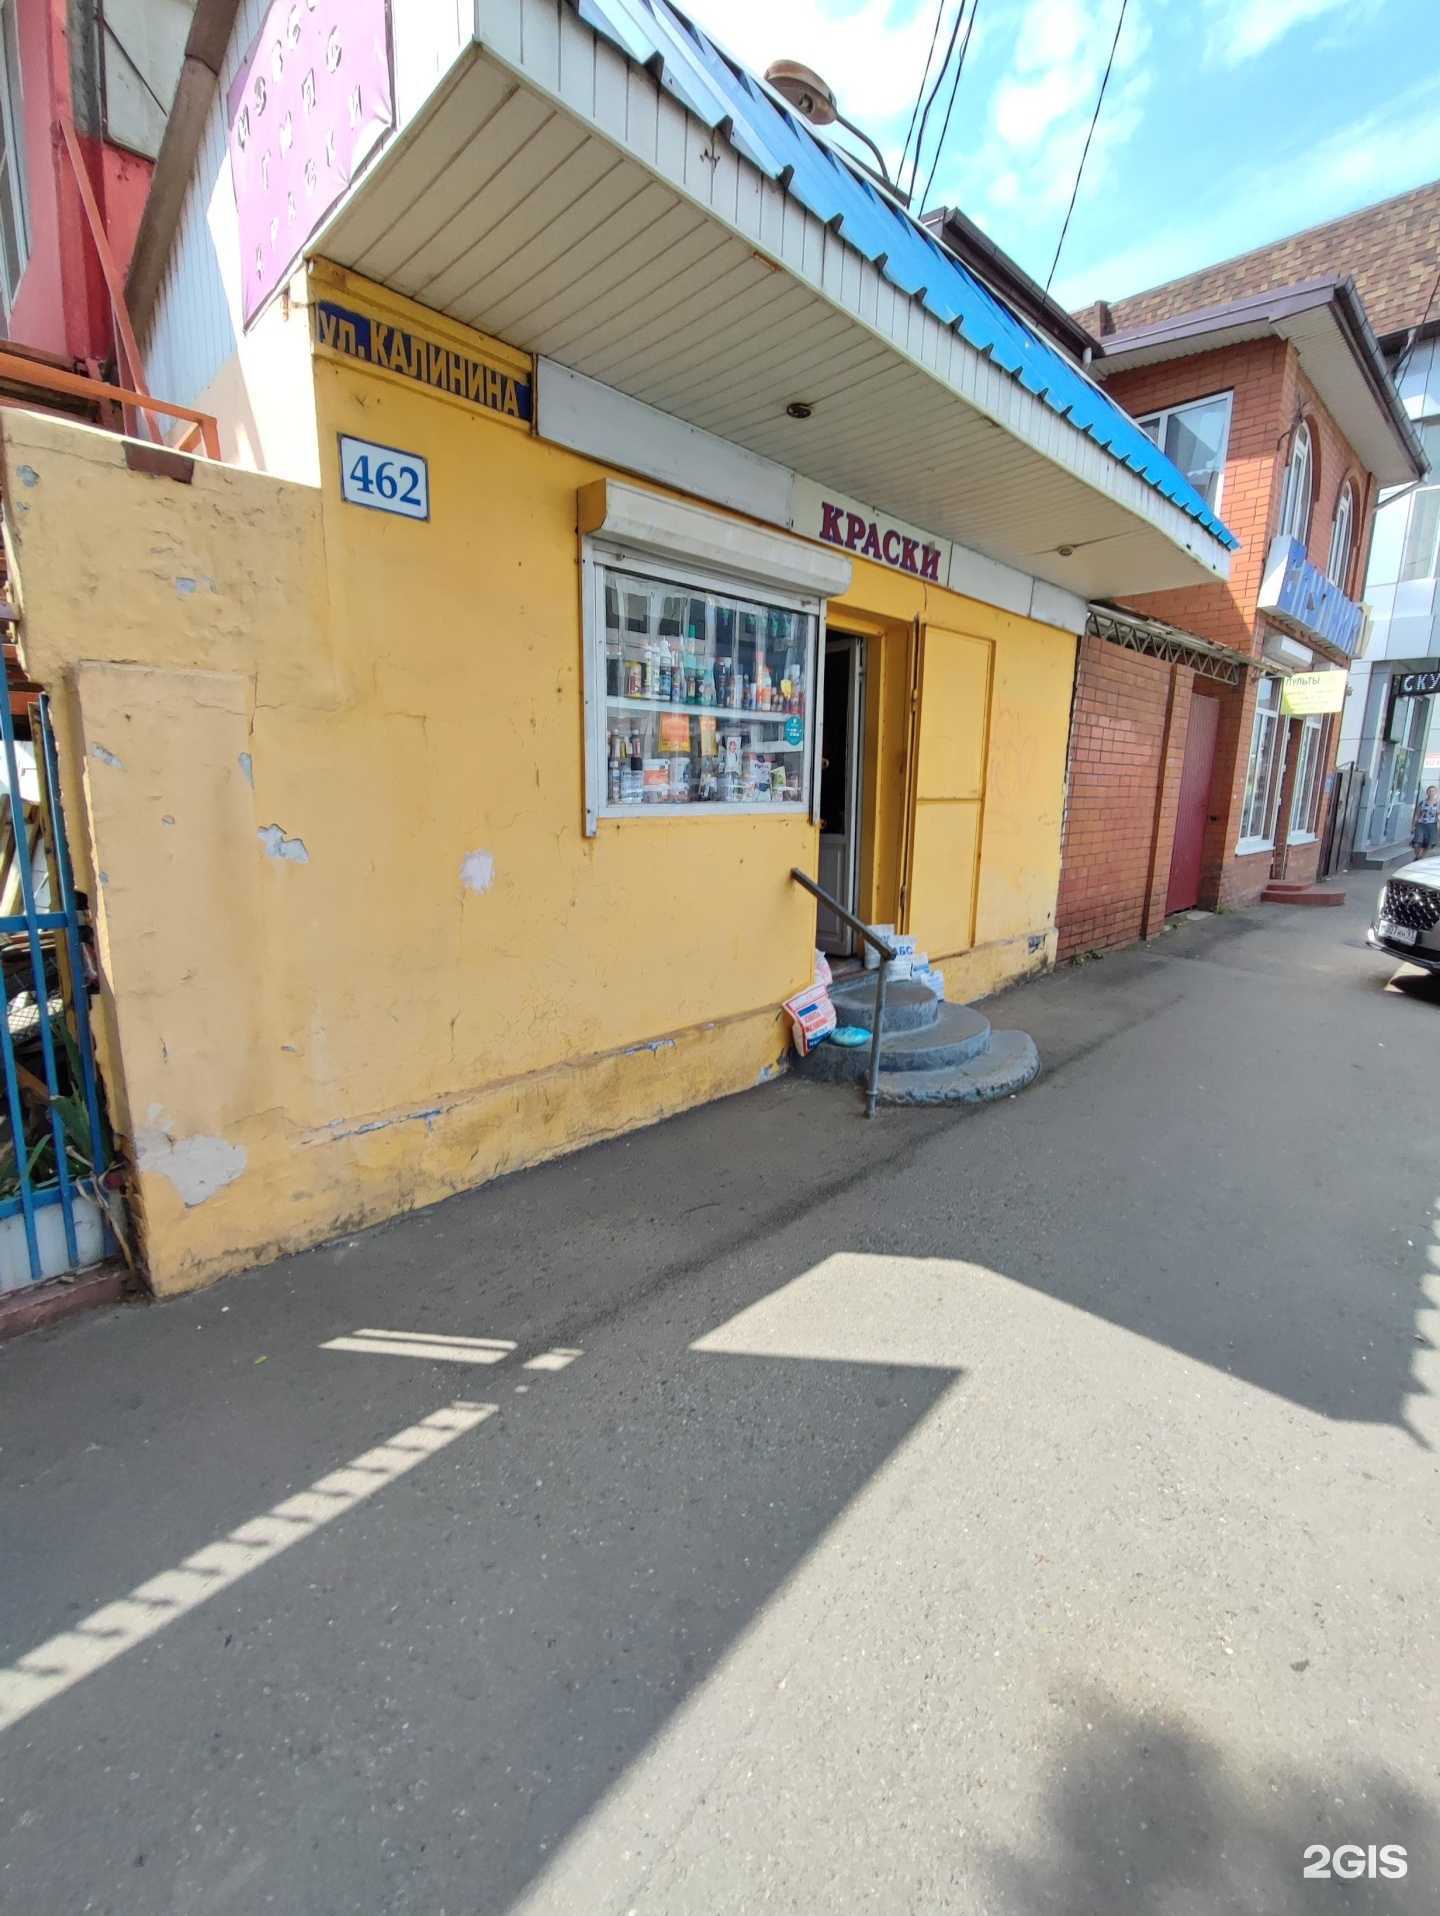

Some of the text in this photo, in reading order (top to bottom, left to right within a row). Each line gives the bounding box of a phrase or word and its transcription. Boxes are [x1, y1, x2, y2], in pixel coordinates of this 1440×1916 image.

[368, 319, 520, 417] КАЛИНИНА
[350, 455, 421, 506] 462
[819, 501, 941, 581] КРАСКИ
